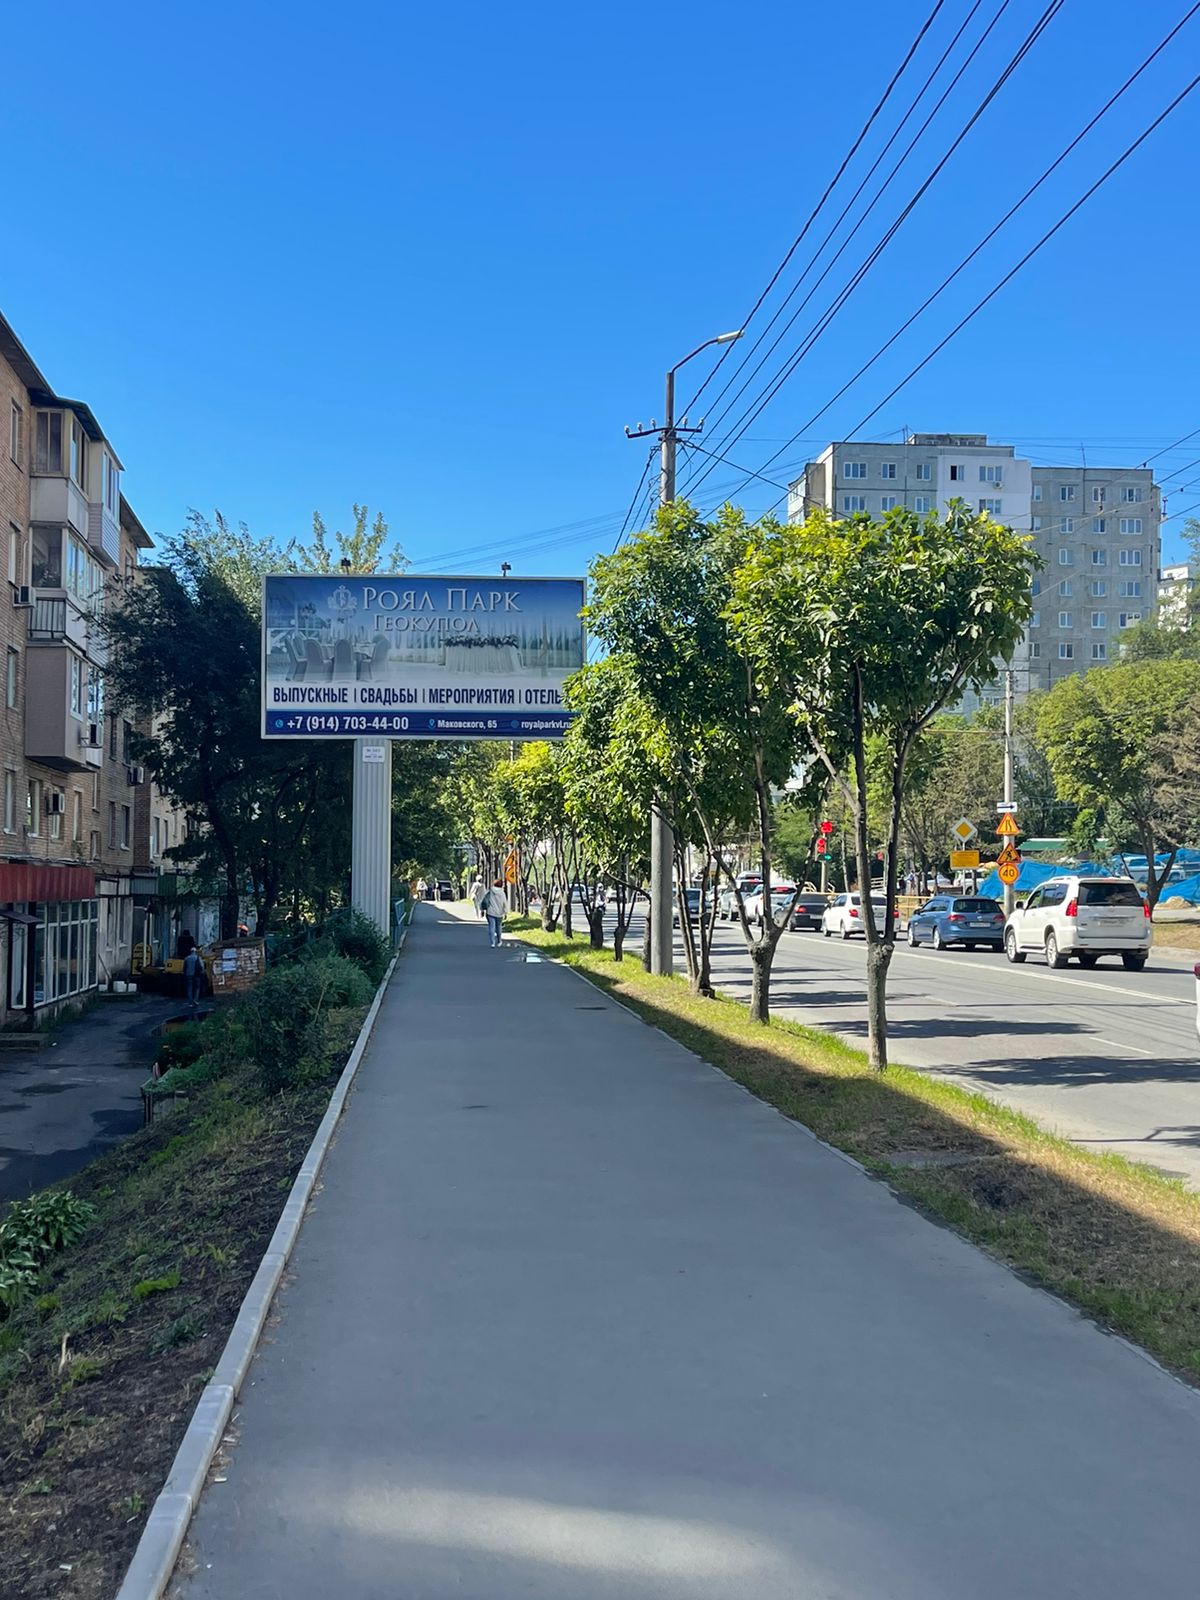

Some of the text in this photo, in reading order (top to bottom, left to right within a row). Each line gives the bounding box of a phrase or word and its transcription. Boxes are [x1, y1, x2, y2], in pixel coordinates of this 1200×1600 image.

[273, 687, 562, 706] ВЫПУСКНЫЕ СВАДЬБЫ МЕРОПРИЯТИЯ ОТЕЛЬ
[287, 716, 409, 732] +7 (914) 703-44-00
[437, 720, 486, 730] Маковского,
[1003, 869, 1015, 877] 40
